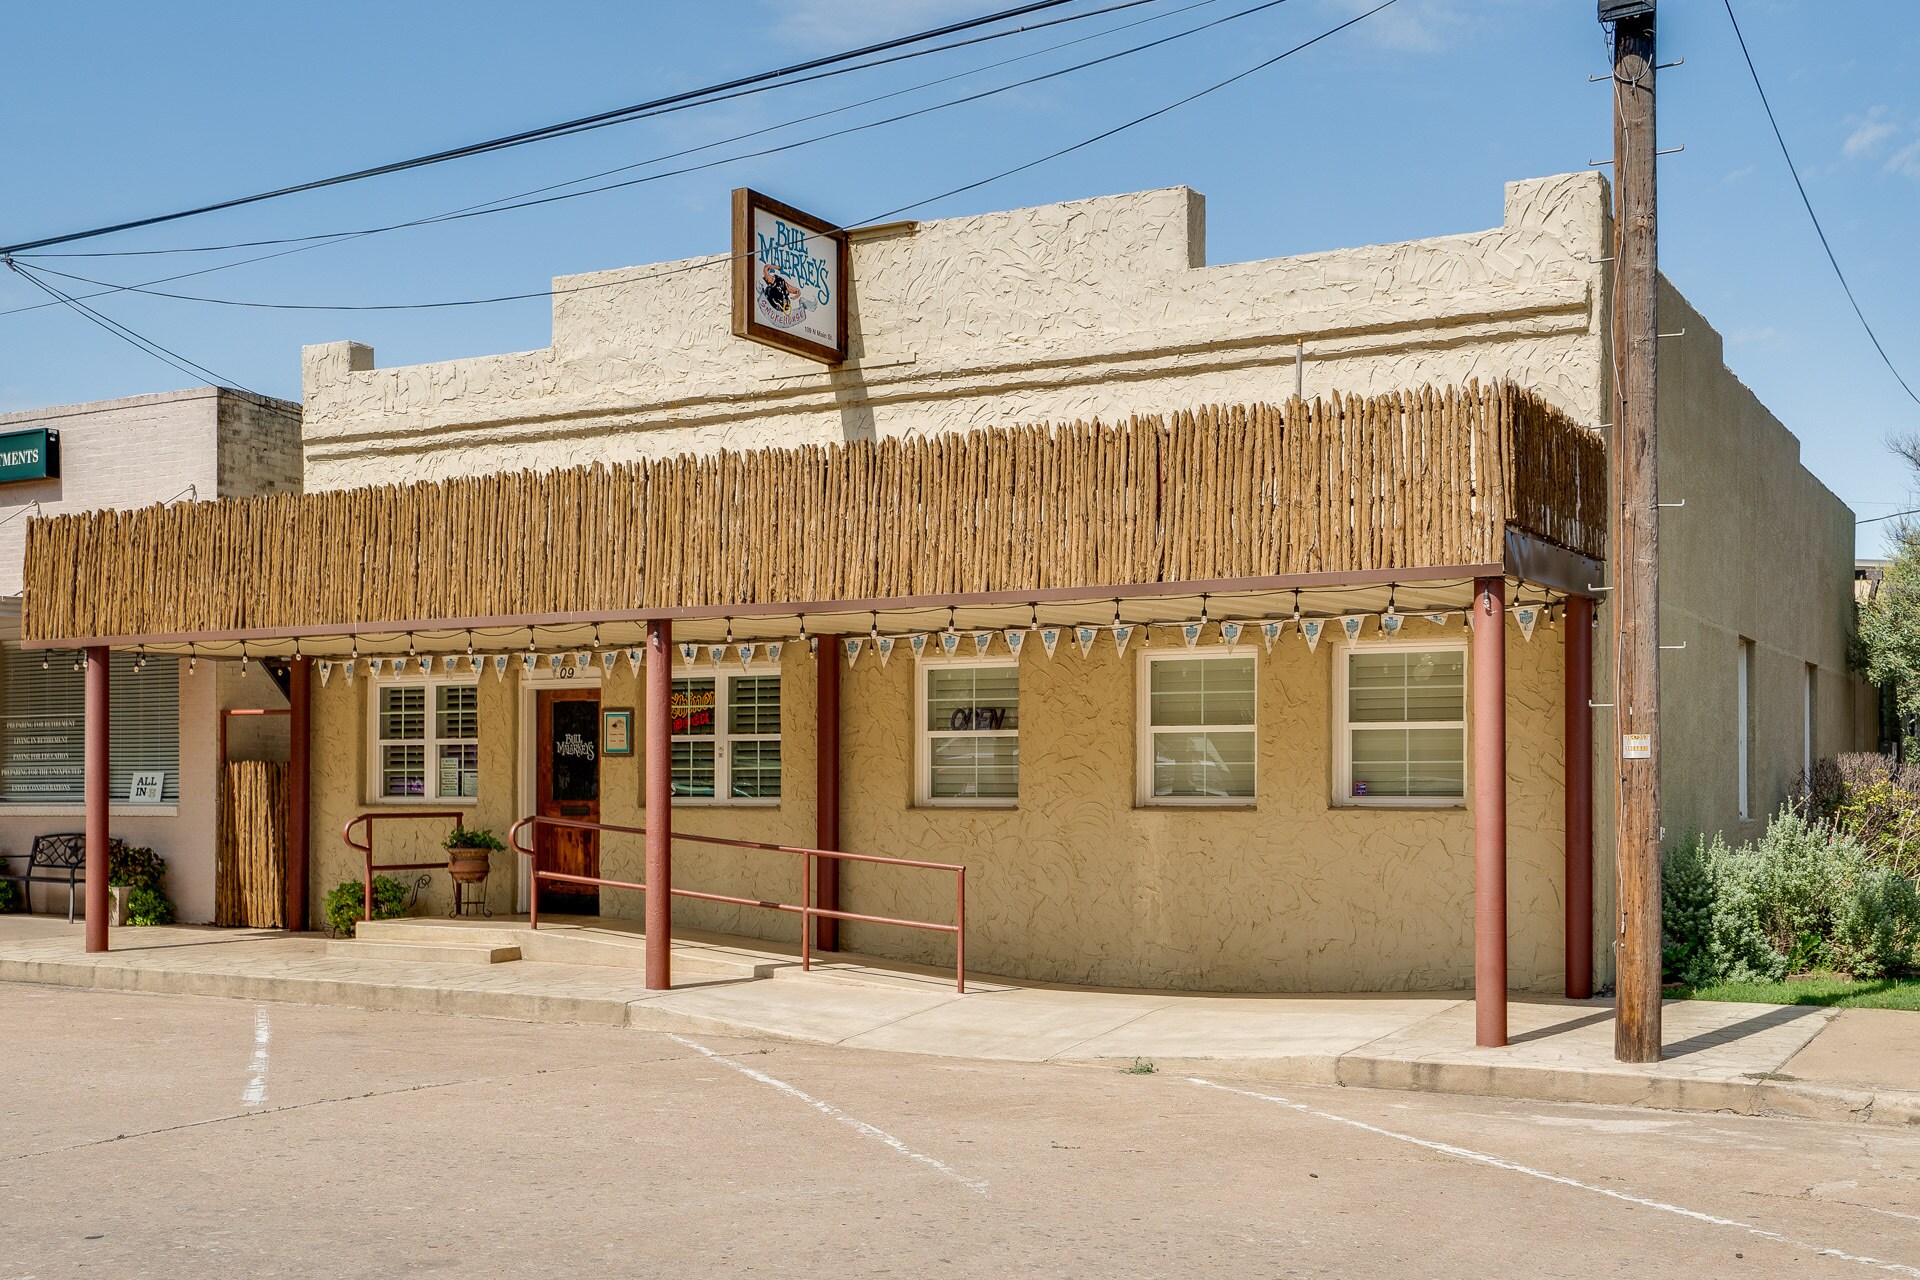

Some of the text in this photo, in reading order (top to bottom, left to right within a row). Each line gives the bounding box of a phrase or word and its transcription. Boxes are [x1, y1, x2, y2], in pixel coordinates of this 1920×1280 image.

[776, 220, 808, 255] BULL
[758, 232, 830, 306] MALARKEY'S
[760, 300, 804, 326] SMOKEHOUSE
[804, 325, 812, 334] 109
[817, 330, 827, 339] Main
[557, 667, 575, 679] 09
[951, 707, 1006, 731] OPEN
[565, 733, 583, 745] BULL
[137, 776, 157, 786] ALL
[135, 787, 147, 796] IN
